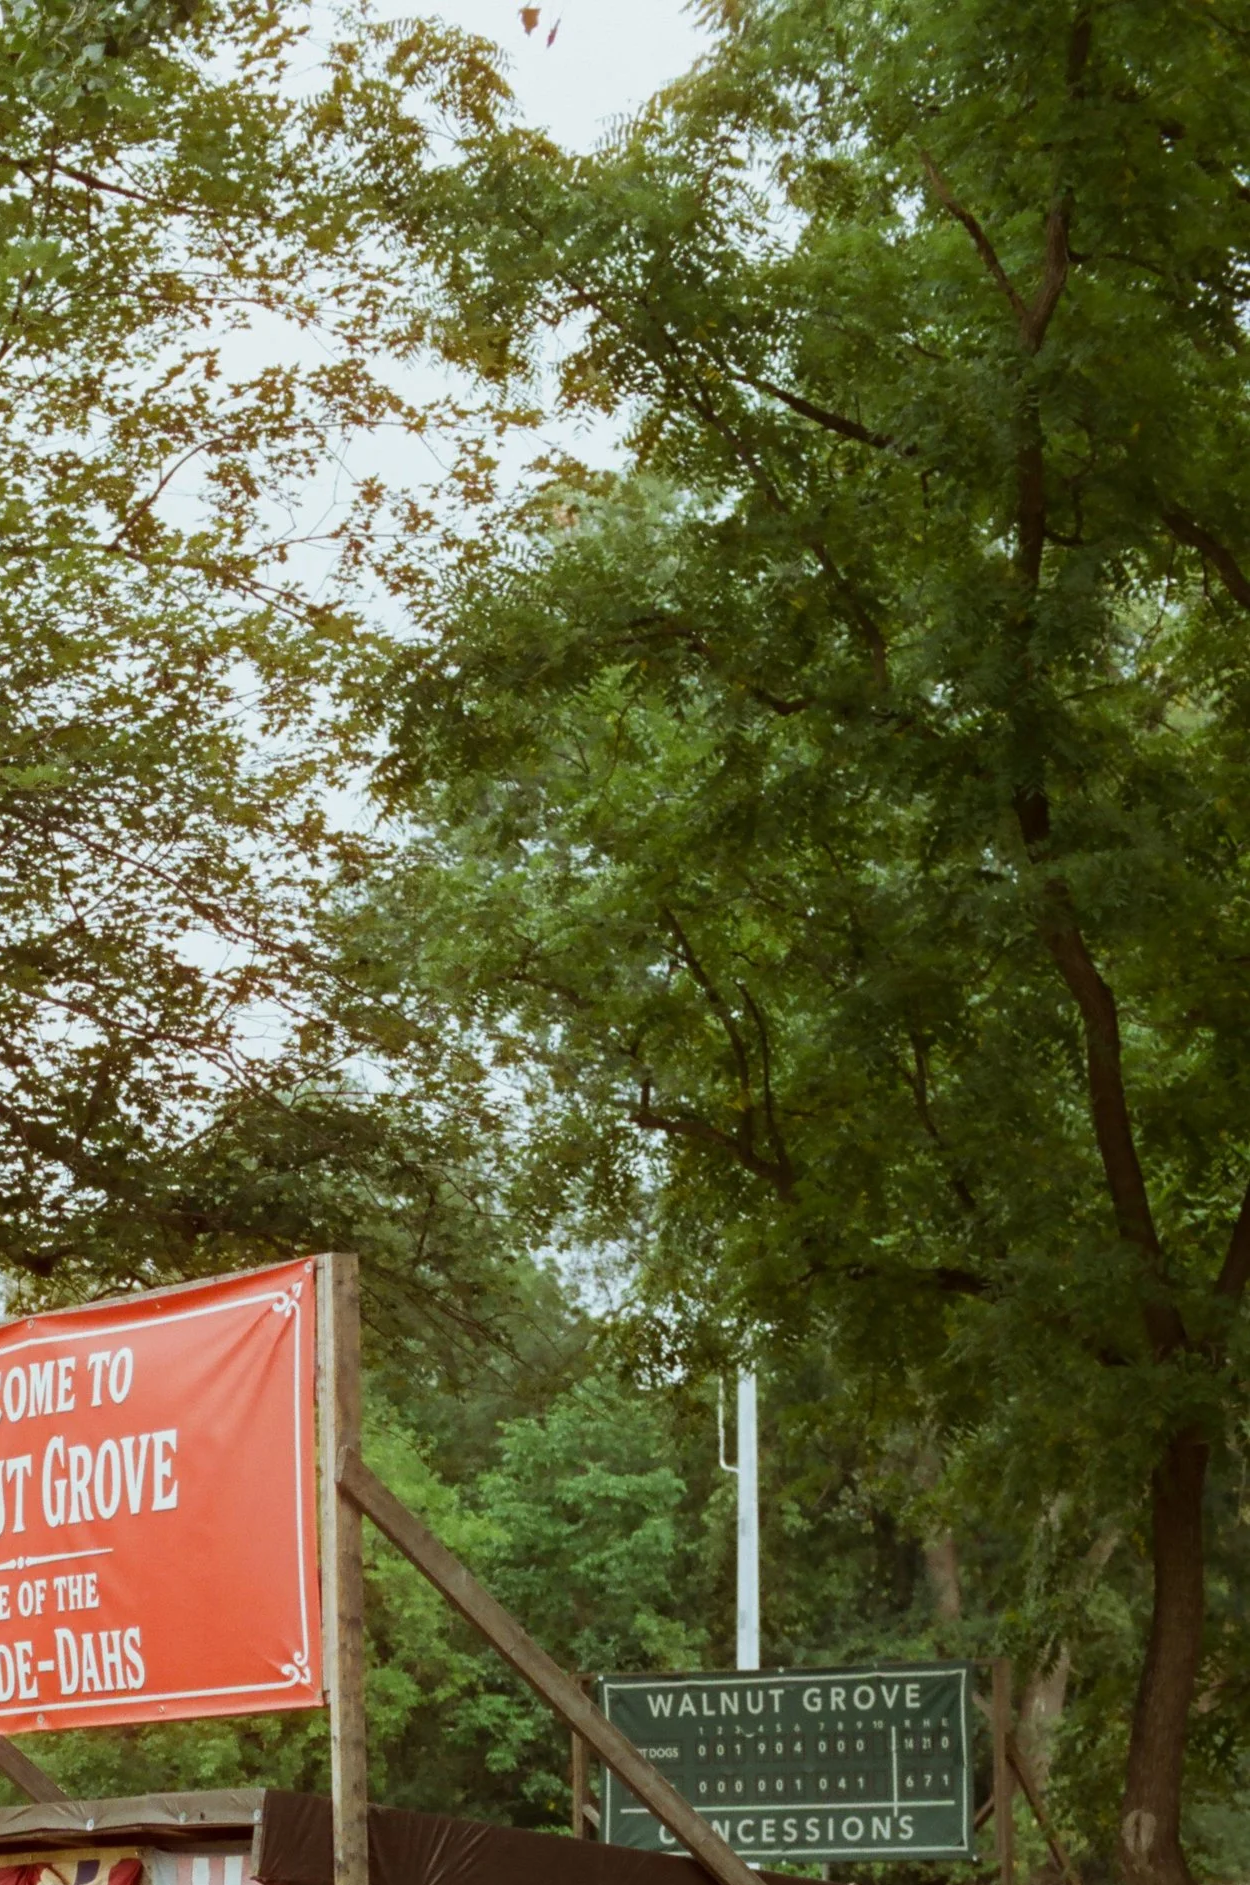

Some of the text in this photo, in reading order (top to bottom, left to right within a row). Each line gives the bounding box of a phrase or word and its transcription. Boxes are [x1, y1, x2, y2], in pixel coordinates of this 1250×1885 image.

[87, 1346, 135, 1408] TO
[41, 1428, 179, 1529] GROVE
[17, 1578, 47, 1617] OF
[53, 1572, 100, 1612] THE
[646, 1683, 922, 1719] WALNUT GROVE
[698, 1717, 949, 1736] 1 2 3 4 5 6 7 8 9 10 R H E
[648, 1746, 679, 1759] DOGS
[697, 1744, 707, 1757] 0
[716, 1743, 725, 1757] 0
[734, 1743, 742, 1756] 1
[757, 1742, 767, 1755] 9
[775, 1741, 784, 1755] 0
[793, 1741, 803, 1754] 4
[817, 1739, 827, 1753] 0
[836, 1739, 846, 1753] 0
[855, 1738, 865, 1752] 0
[921, 1736, 932, 1750] 21
[940, 1735, 950, 1750] 0
[698, 1773, 949, 1794] 0 0 0 0 0 1 0 4 1 6 7 1
[658, 1814, 915, 1846] CNCESSIONS
